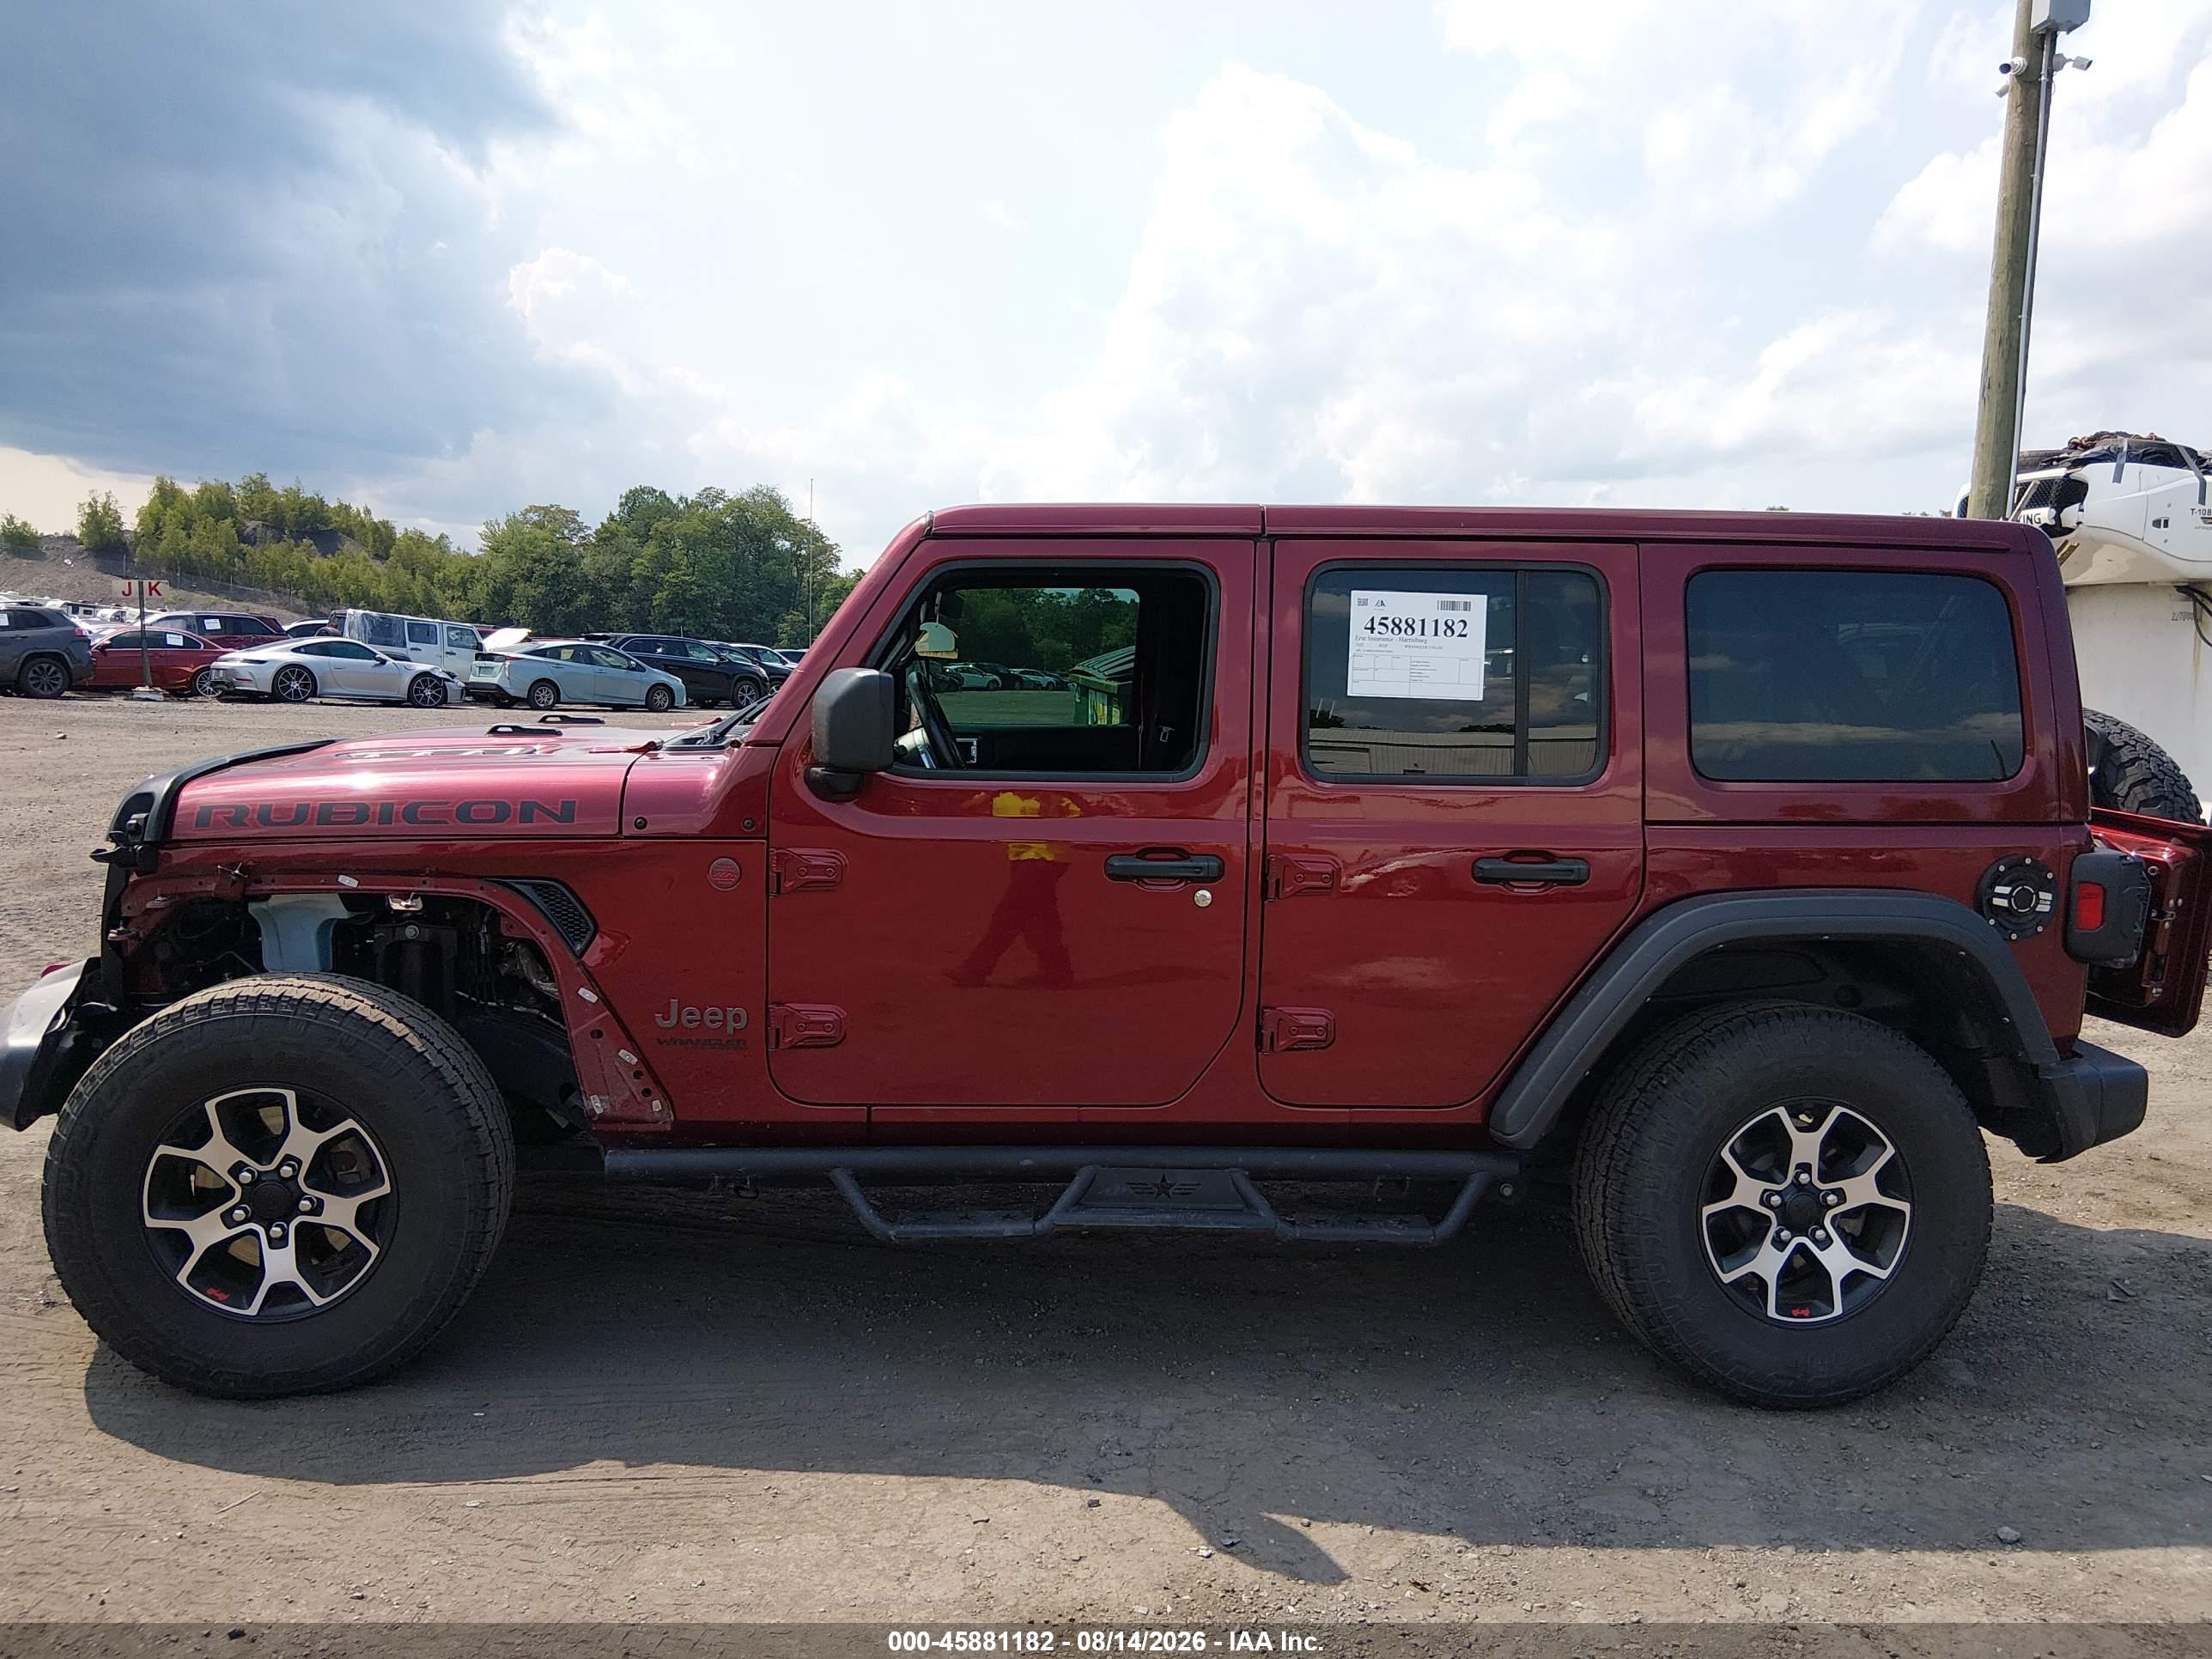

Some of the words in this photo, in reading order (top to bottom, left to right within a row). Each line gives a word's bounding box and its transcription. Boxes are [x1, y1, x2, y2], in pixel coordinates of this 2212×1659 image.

[122, 581, 132, 597] J
[149, 581, 162, 597] K
[1364, 616, 1468, 638] 45881182
[194, 799, 577, 829] RUBICON
[654, 999, 749, 1035] Jeep
